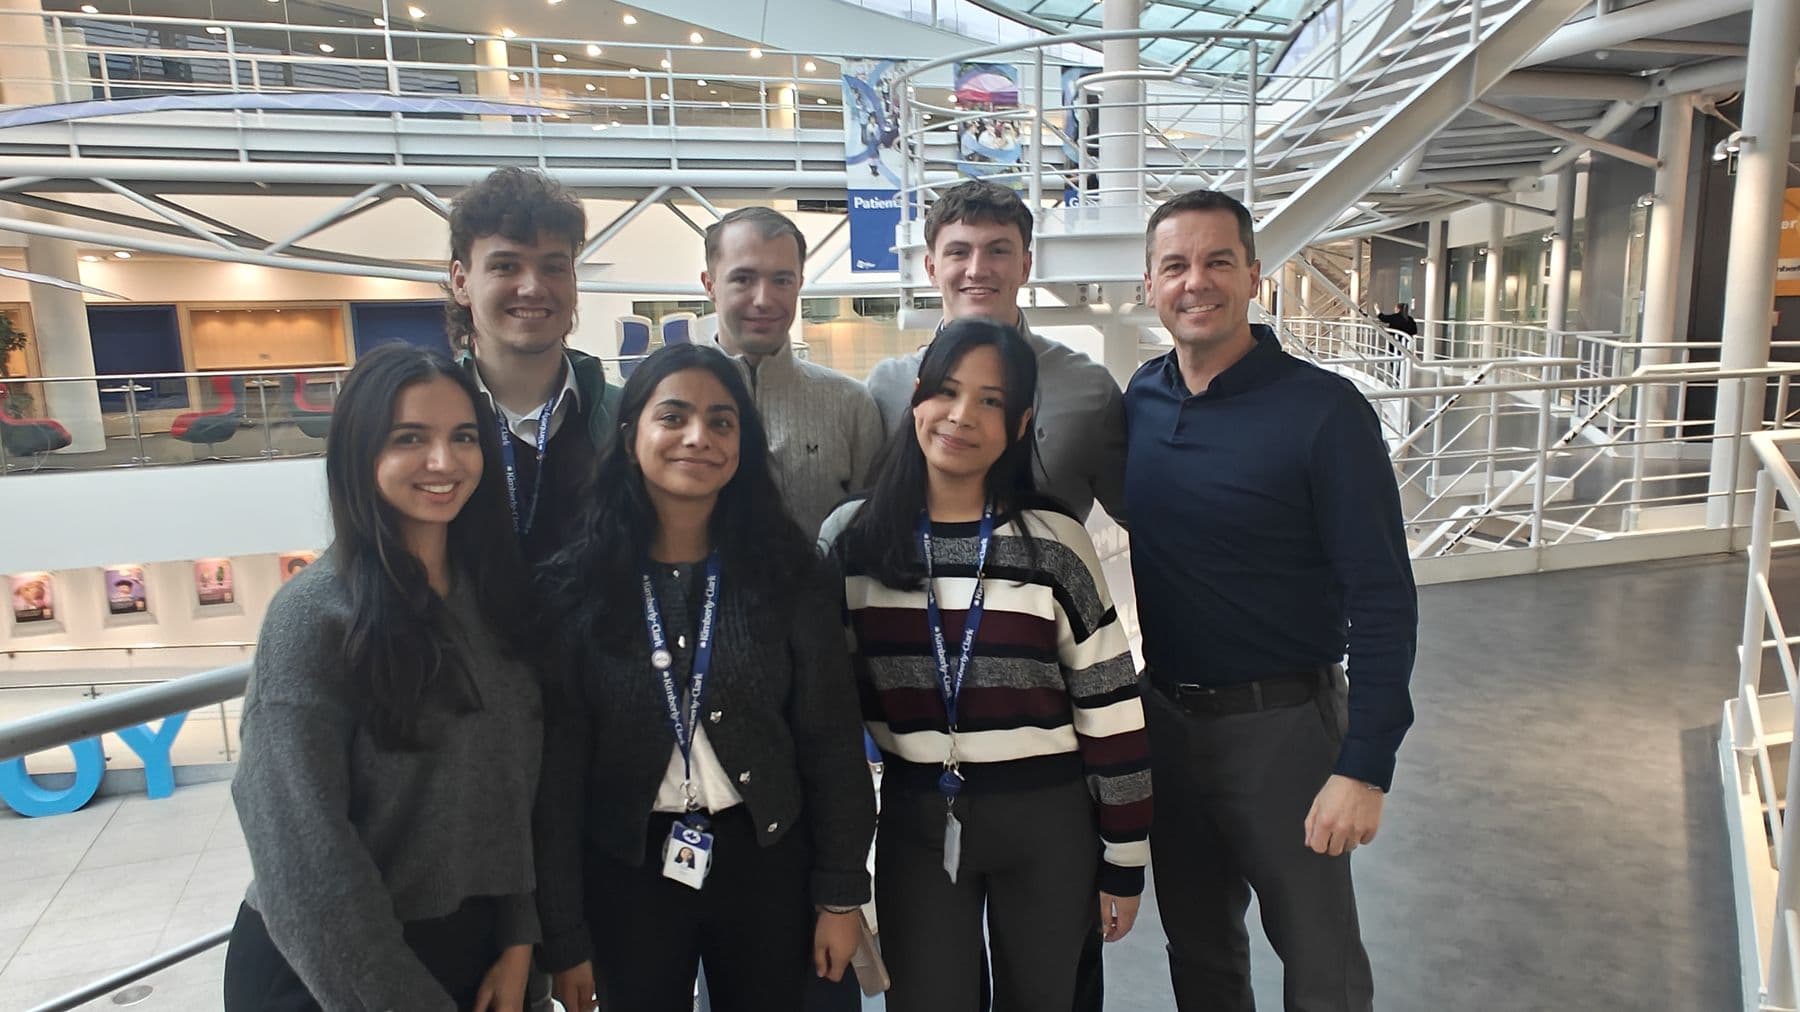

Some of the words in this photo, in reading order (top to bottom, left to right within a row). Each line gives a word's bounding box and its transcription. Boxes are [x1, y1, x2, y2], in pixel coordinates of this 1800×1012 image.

[643, 581, 664, 648] Kimberly-Clark
[700, 575, 717, 641] Kimberly-Clark
[934, 632, 953, 699] Kimberly-Clark
[664, 678, 685, 746] Kimberly-Clark
